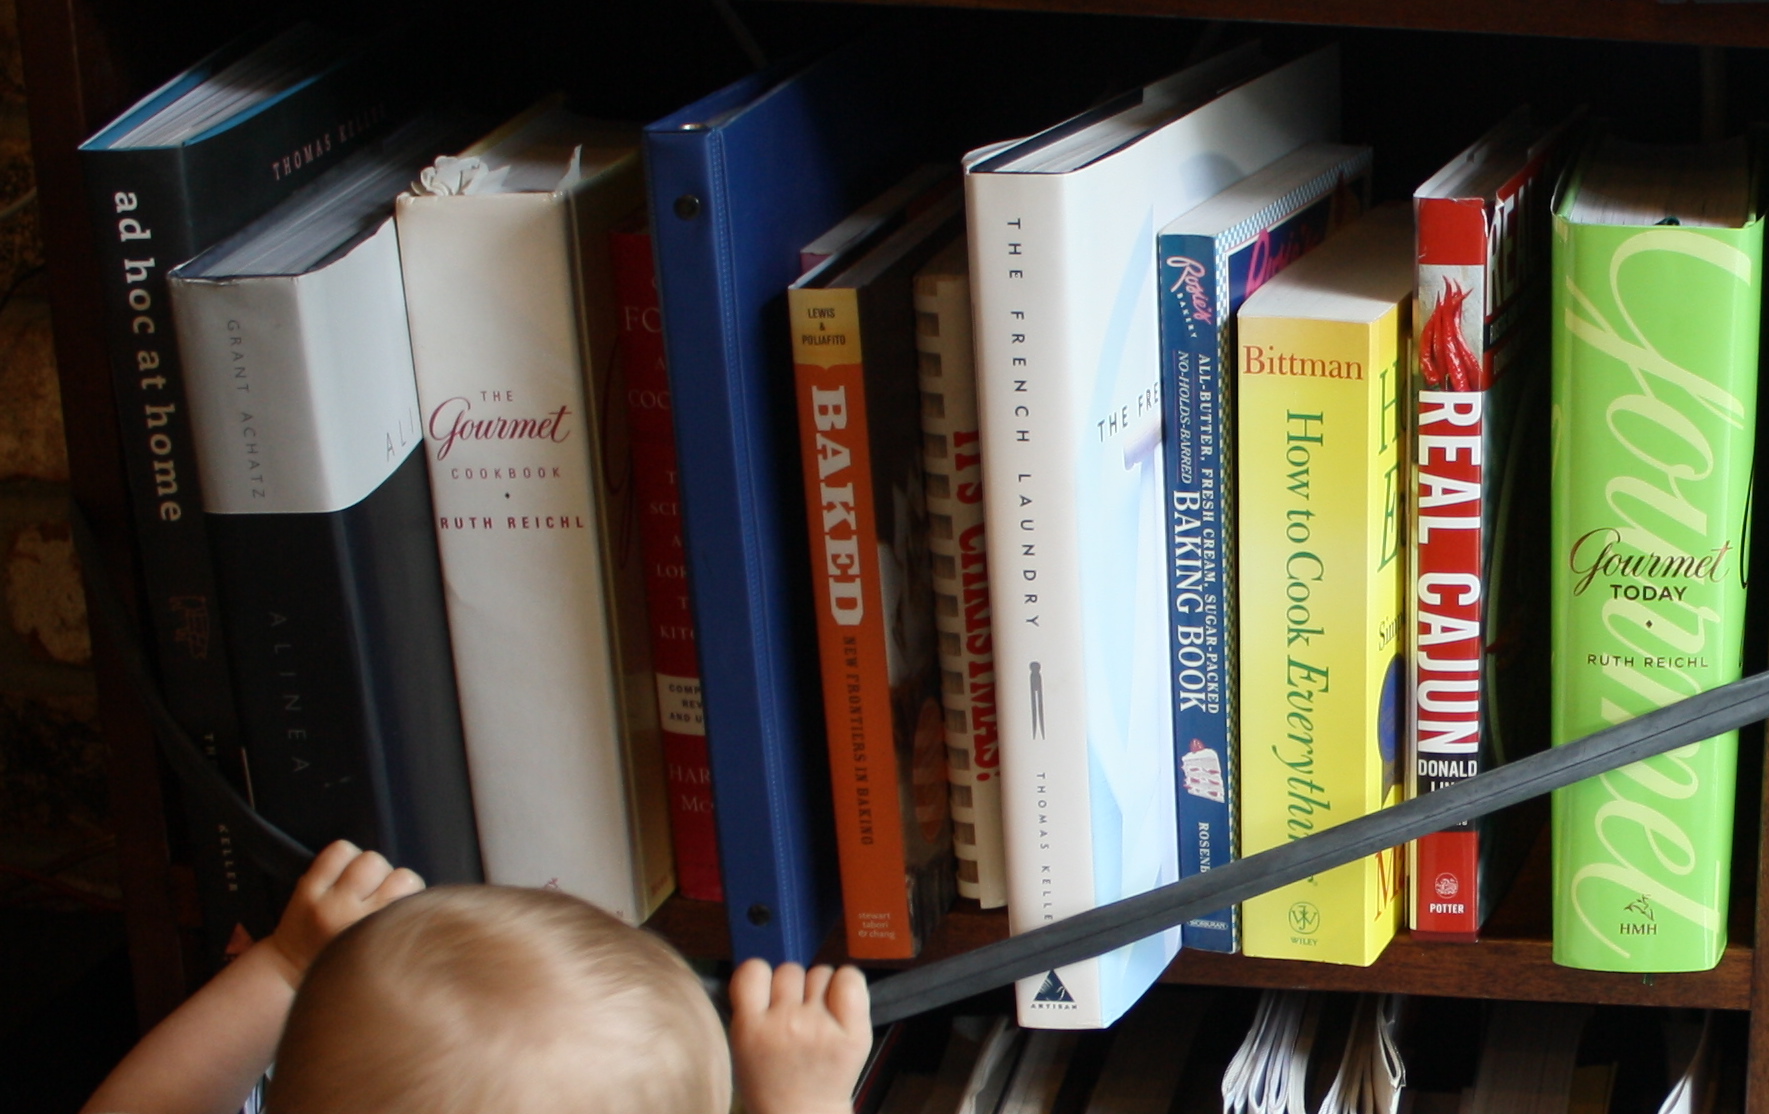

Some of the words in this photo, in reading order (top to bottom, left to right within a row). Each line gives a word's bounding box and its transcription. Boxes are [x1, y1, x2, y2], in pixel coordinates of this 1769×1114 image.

[114, 190, 151, 242] ad
[1007, 218, 1023, 279] THE
[123, 256, 155, 336] hoc
[137, 349, 166, 393] at
[481, 390, 514, 402] THE
[1011, 311, 1030, 442] FRENCH
[1242, 344, 1363, 381] Bittman
[227, 318, 249, 395] GRANT
[240, 412, 265, 499] ACHATZ
[429, 396, 571, 461] Gourmet
[1178, 351, 1193, 484] NO-HOLDS-BARRED
[144, 405, 182, 523] home
[451, 467, 562, 479] COOKBOOK
[1286, 409, 1324, 501] How
[1418, 390, 1482, 544] REAL
[440, 516, 495, 531] RUTH
[507, 516, 585, 530] REICHL
[811, 385, 863, 626] BAKED
[1202, 469, 1214, 520] FRESH
[1286, 510, 1316, 544] to
[1018, 473, 1039, 627] LAUNDRY
[1173, 491, 1204, 613] BAKING
[1569, 527, 1733, 597] Gourmet
[1286, 552, 1325, 647] Cook
[1610, 584, 1688, 602] TODAY
[1177, 626, 1206, 713] BOOK
[1204, 594, 1220, 714] SUGAR-PACKED
[1417, 572, 1480, 753] CAJUN
[1587, 654, 1635, 668] RUTH
[1644, 655, 1709, 668] REICHL
[268, 610, 310, 776] ALINEA
[1418, 759, 1477, 778] DONALD
[1036, 772, 1050, 849] THOMAS
[1430, 903, 1464, 914] POTTER
